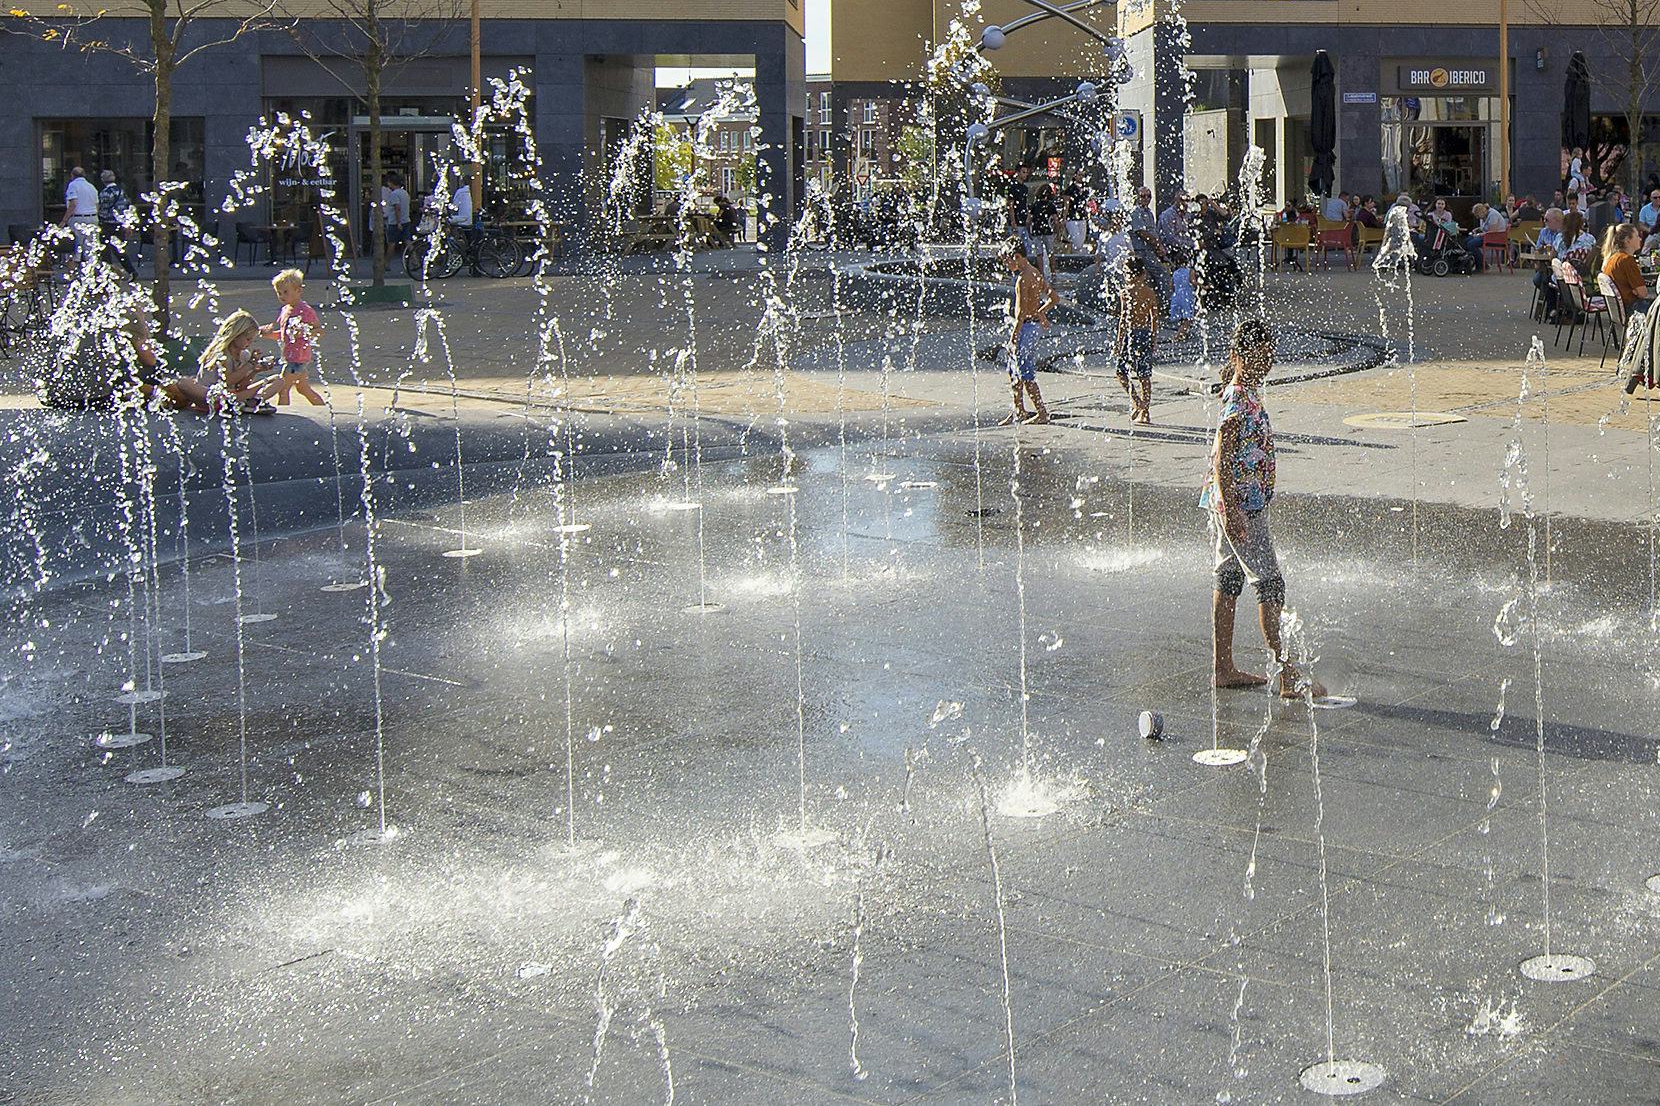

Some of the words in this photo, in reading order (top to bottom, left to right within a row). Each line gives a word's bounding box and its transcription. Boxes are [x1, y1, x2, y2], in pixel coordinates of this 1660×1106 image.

[1410, 70, 1430, 84] BAR
[1449, 70, 1485, 84] IBERICO
[279, 178, 300, 186] wijn-
